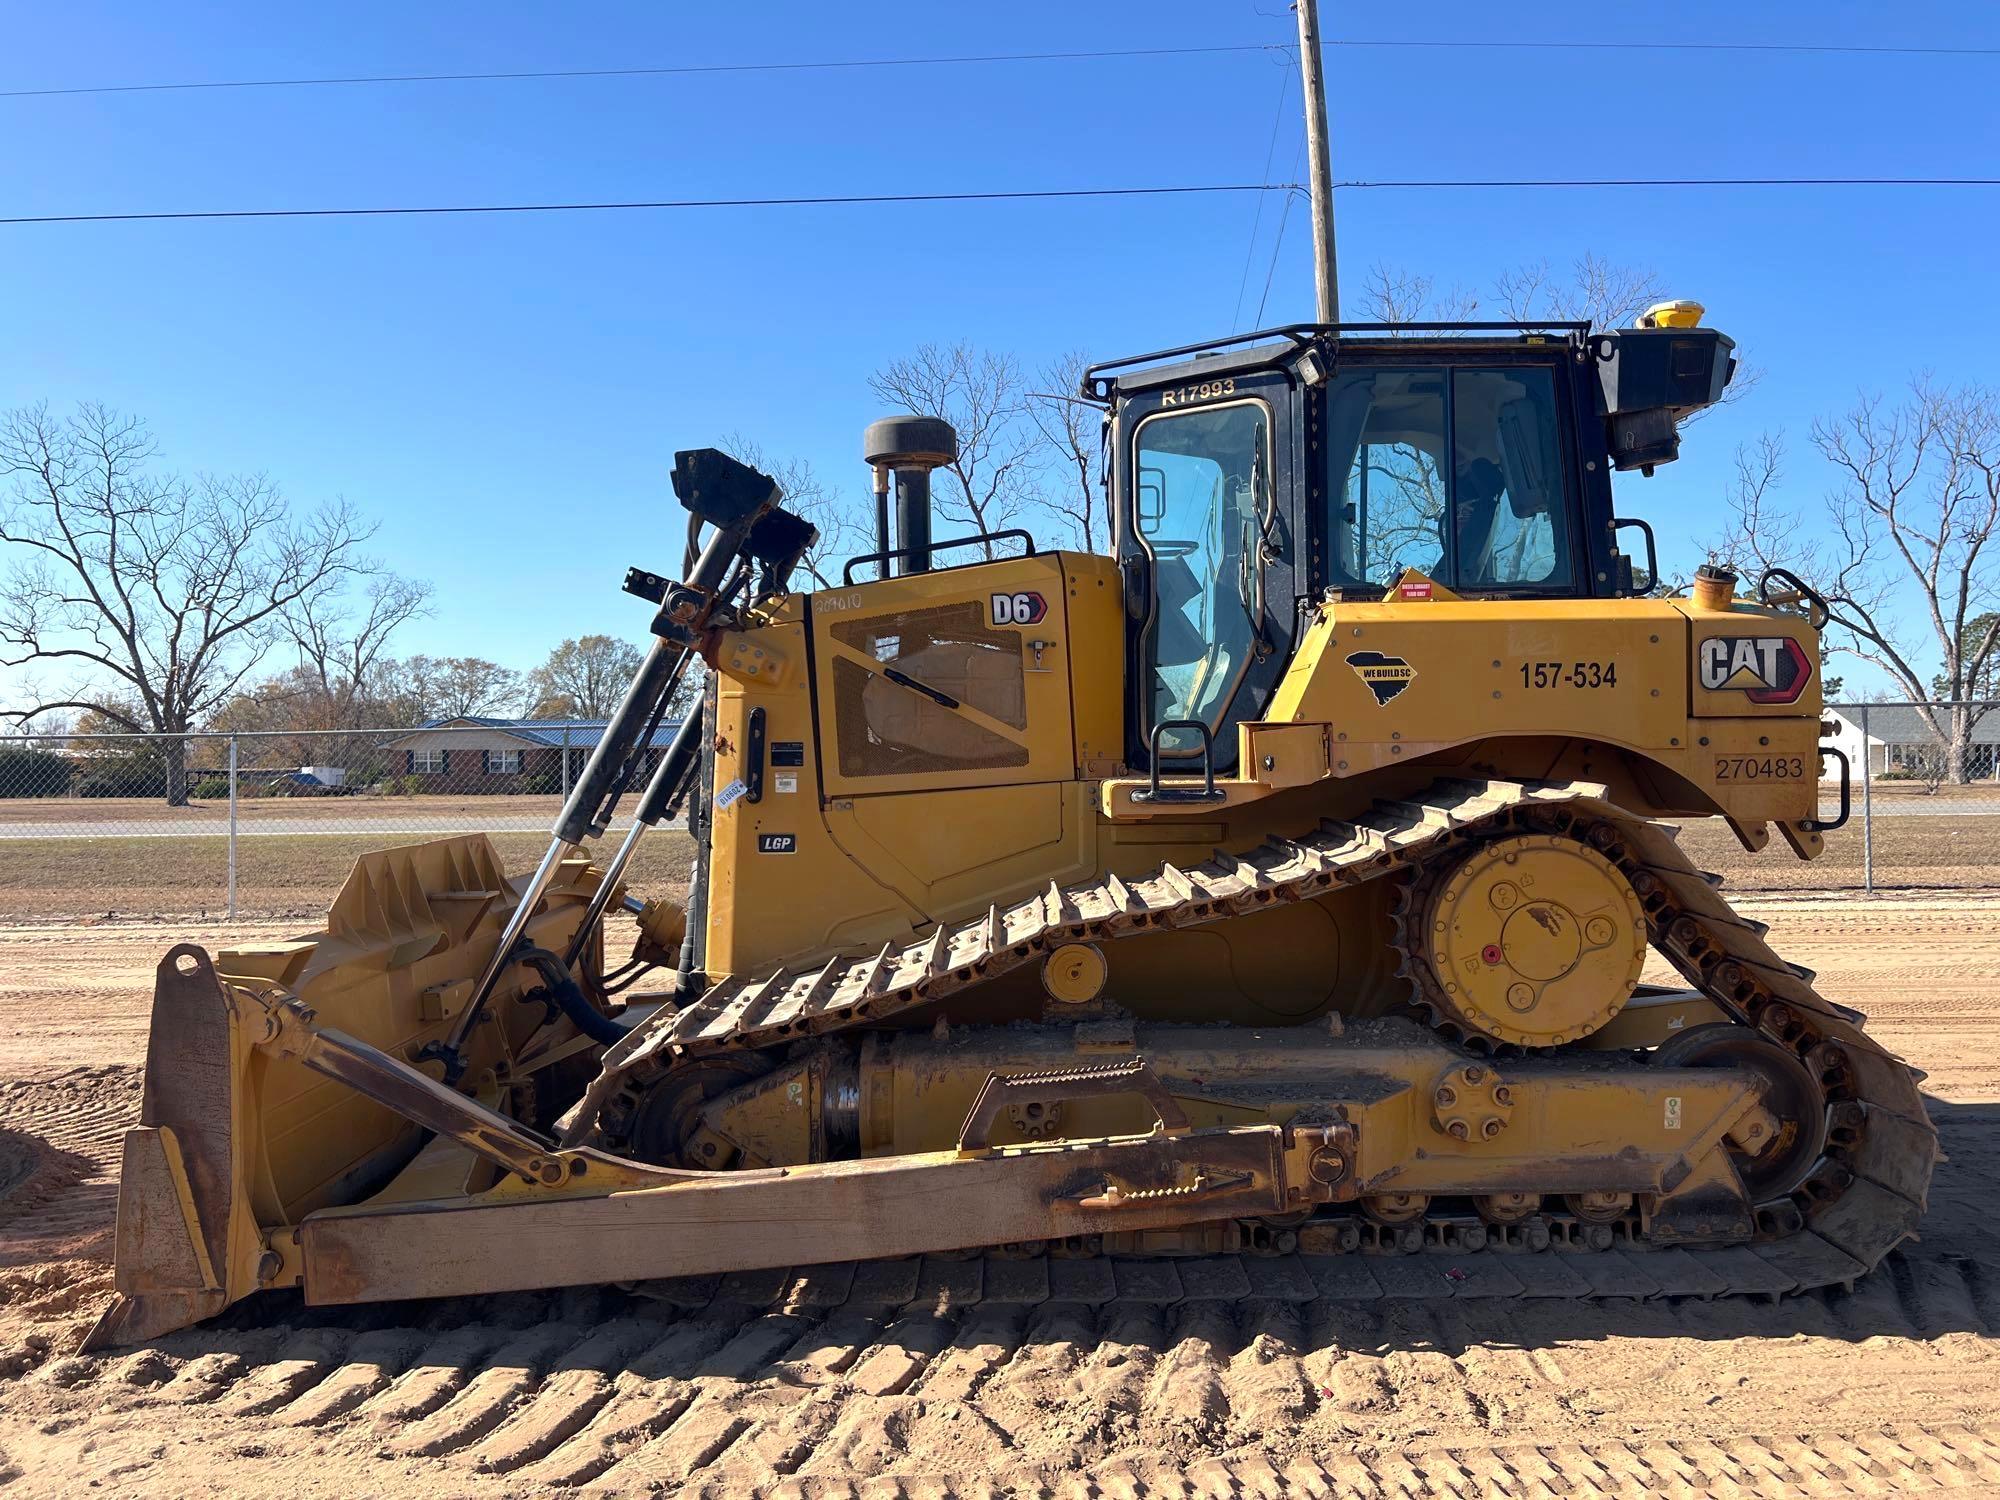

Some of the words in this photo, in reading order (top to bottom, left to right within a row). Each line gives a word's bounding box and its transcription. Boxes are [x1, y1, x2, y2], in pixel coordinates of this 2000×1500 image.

[1162, 379, 1235, 406] R17993
[815, 593, 862, 614] 209010
[992, 593, 1031, 624] D6
[1363, 669, 1376, 678] WE
[1376, 668, 1399, 678] BUILD
[1400, 668, 1411, 677] SC
[1520, 662, 1617, 689] 157-534
[1700, 638, 1784, 689] CAT
[1716, 758, 1803, 779] 270483
[764, 837, 792, 850] LGP
